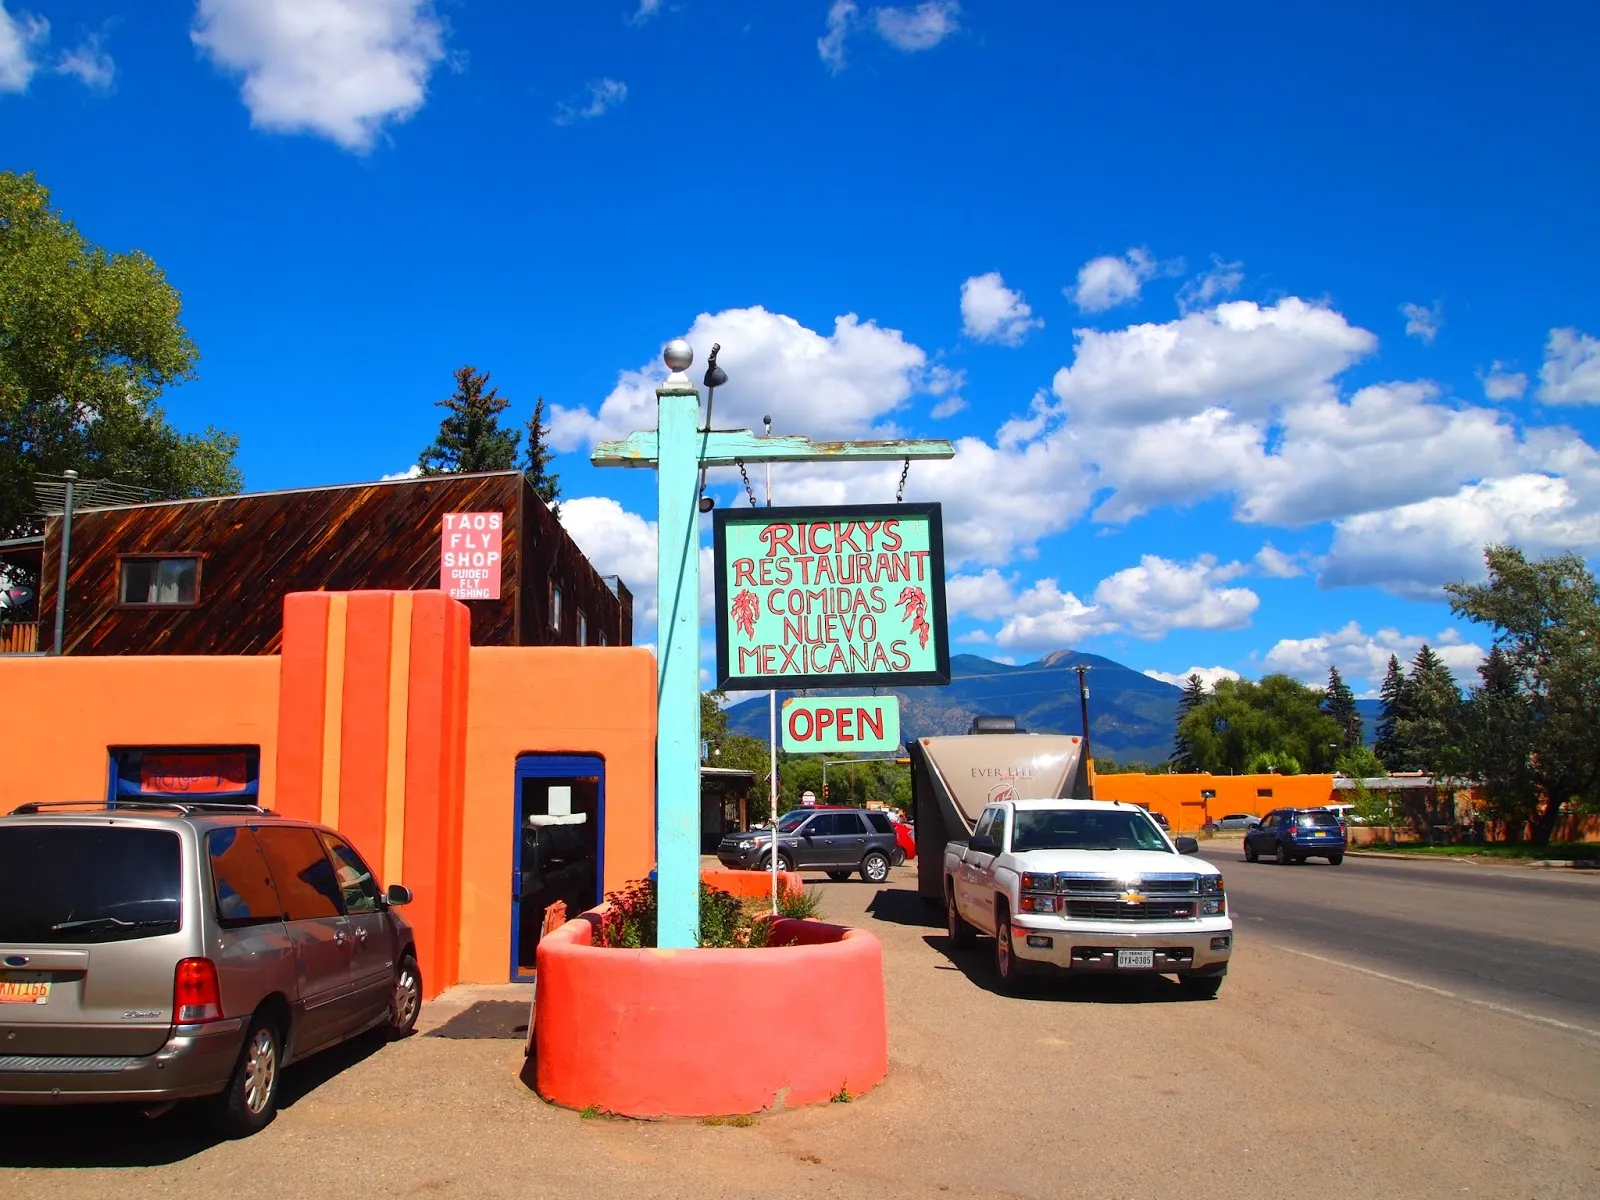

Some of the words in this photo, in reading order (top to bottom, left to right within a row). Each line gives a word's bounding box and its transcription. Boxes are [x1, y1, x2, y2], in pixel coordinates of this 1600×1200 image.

[445, 514, 500, 529] TAOS
[450, 533, 491, 548] FLY
[759, 519, 903, 557] RICKYS
[444, 551, 499, 567] SHOP
[451, 569, 489, 579] GUIDED
[732, 551, 930, 587] RESTAURANT
[460, 579, 480, 588] FLY
[450, 588, 490, 598] FISHING
[767, 586, 887, 616] COMIDAS
[783, 614, 877, 645] NUEVO
[738, 640, 911, 674] MEXICANAS
[788, 707, 884, 742] OPEN
[971, 768, 1002, 778] EVER
